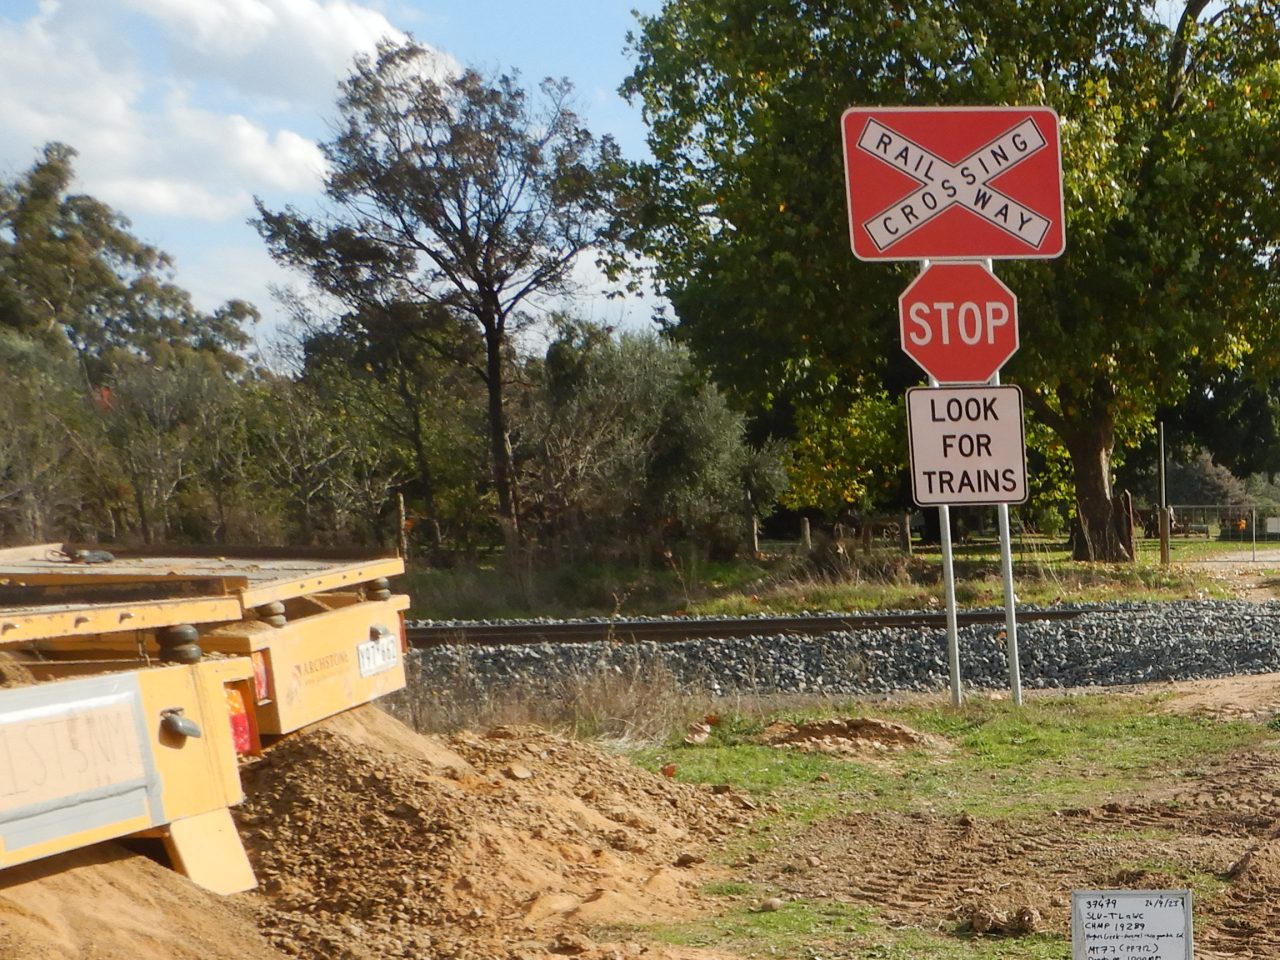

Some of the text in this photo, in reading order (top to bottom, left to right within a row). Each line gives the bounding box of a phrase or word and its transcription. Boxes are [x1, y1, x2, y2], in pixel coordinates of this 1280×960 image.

[875, 132, 1033, 232] RAIL WAY
[882, 133, 1029, 236] CROSSING
[909, 301, 1010, 346] STOP
[930, 397, 999, 422] LOOK
[942, 433, 993, 458] FOR
[923, 468, 1017, 494] TRAINS
[1115, 922, 1145, 931] 19289
